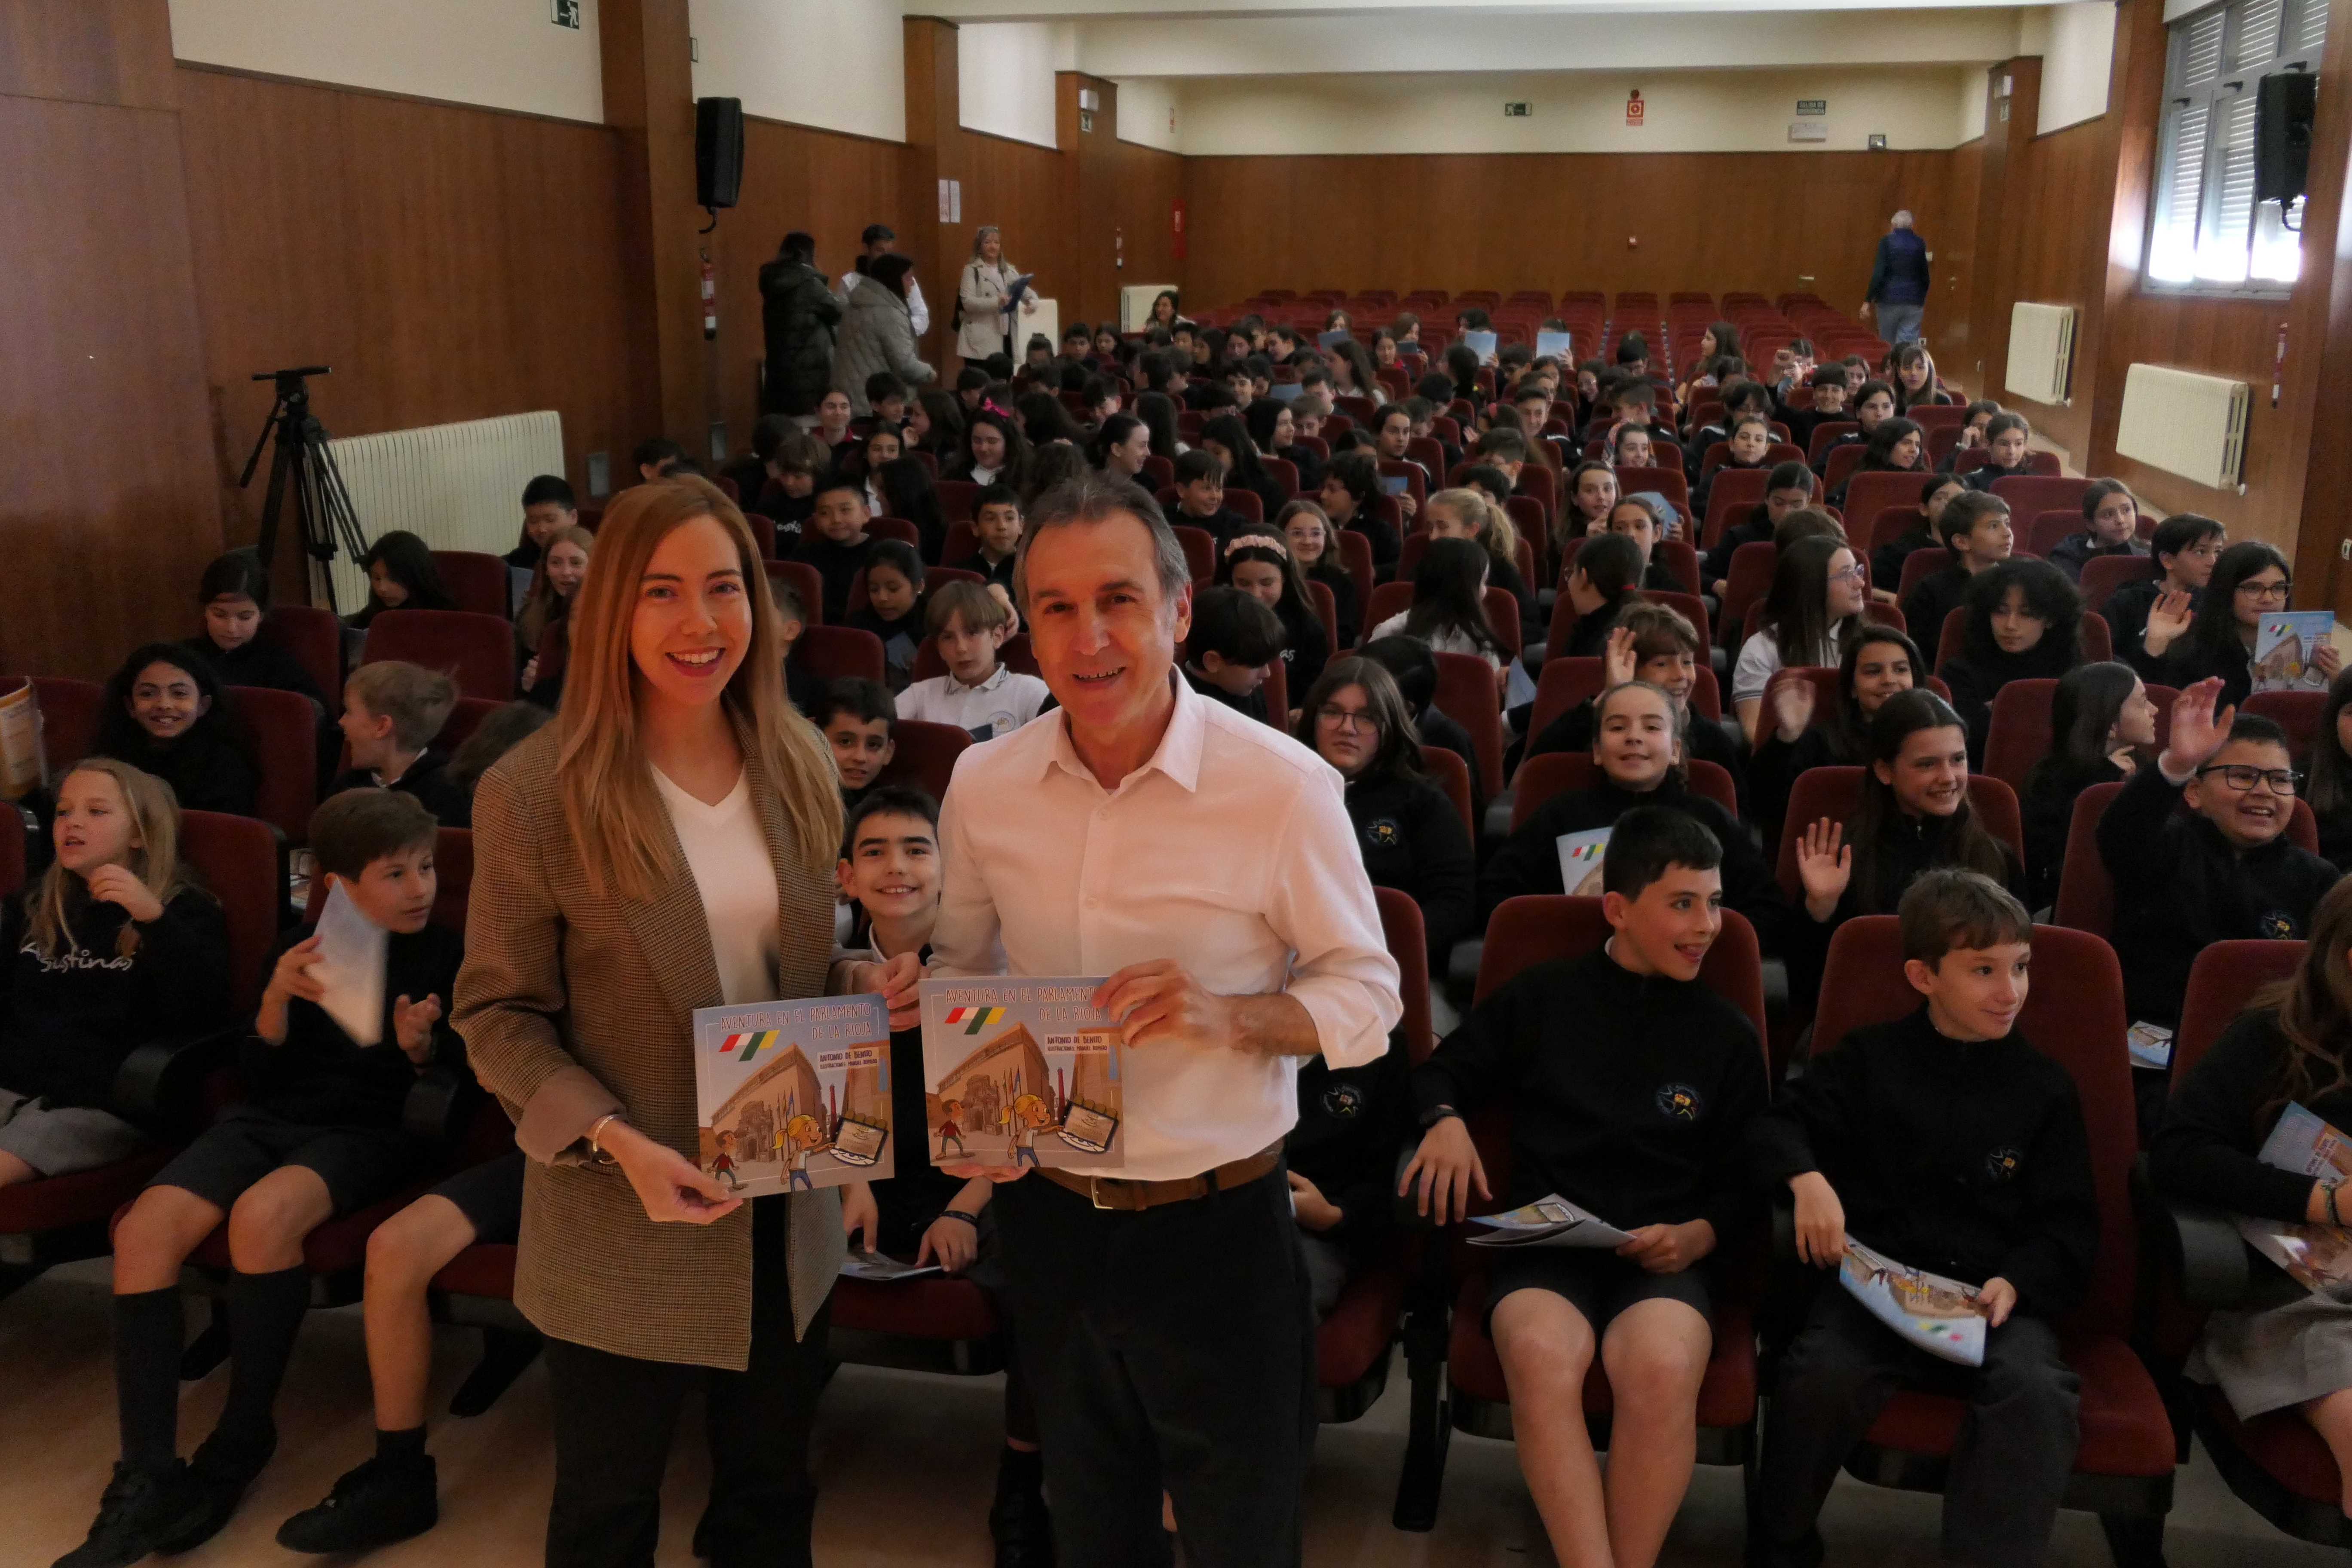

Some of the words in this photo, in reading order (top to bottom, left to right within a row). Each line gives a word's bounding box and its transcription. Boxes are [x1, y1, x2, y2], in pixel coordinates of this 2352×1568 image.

[946, 988, 998, 1004] AVENTURA
[1003, 989, 1016, 1002] EN
[1021, 988, 1032, 1001] EL
[720, 1012, 772, 1032] AVENTURA
[777, 1010, 790, 1025] EN
[794, 1008, 805, 1023] EL
[810, 1002, 871, 1022] PARLAMENTO
[1039, 1007, 1050, 1021] DE
[1057, 1007, 1068, 1021] LA
[1074, 1006, 1102, 1021] RIOJA
[812, 1026, 823, 1040] DE
[828, 1025, 839, 1039] LA
[845, 1022, 871, 1037] RIOJA
[1047, 1036, 1071, 1044] ANTONIO
[820, 1053, 843, 1062] ANTONIO
[854, 1050, 872, 1058] BENITO
